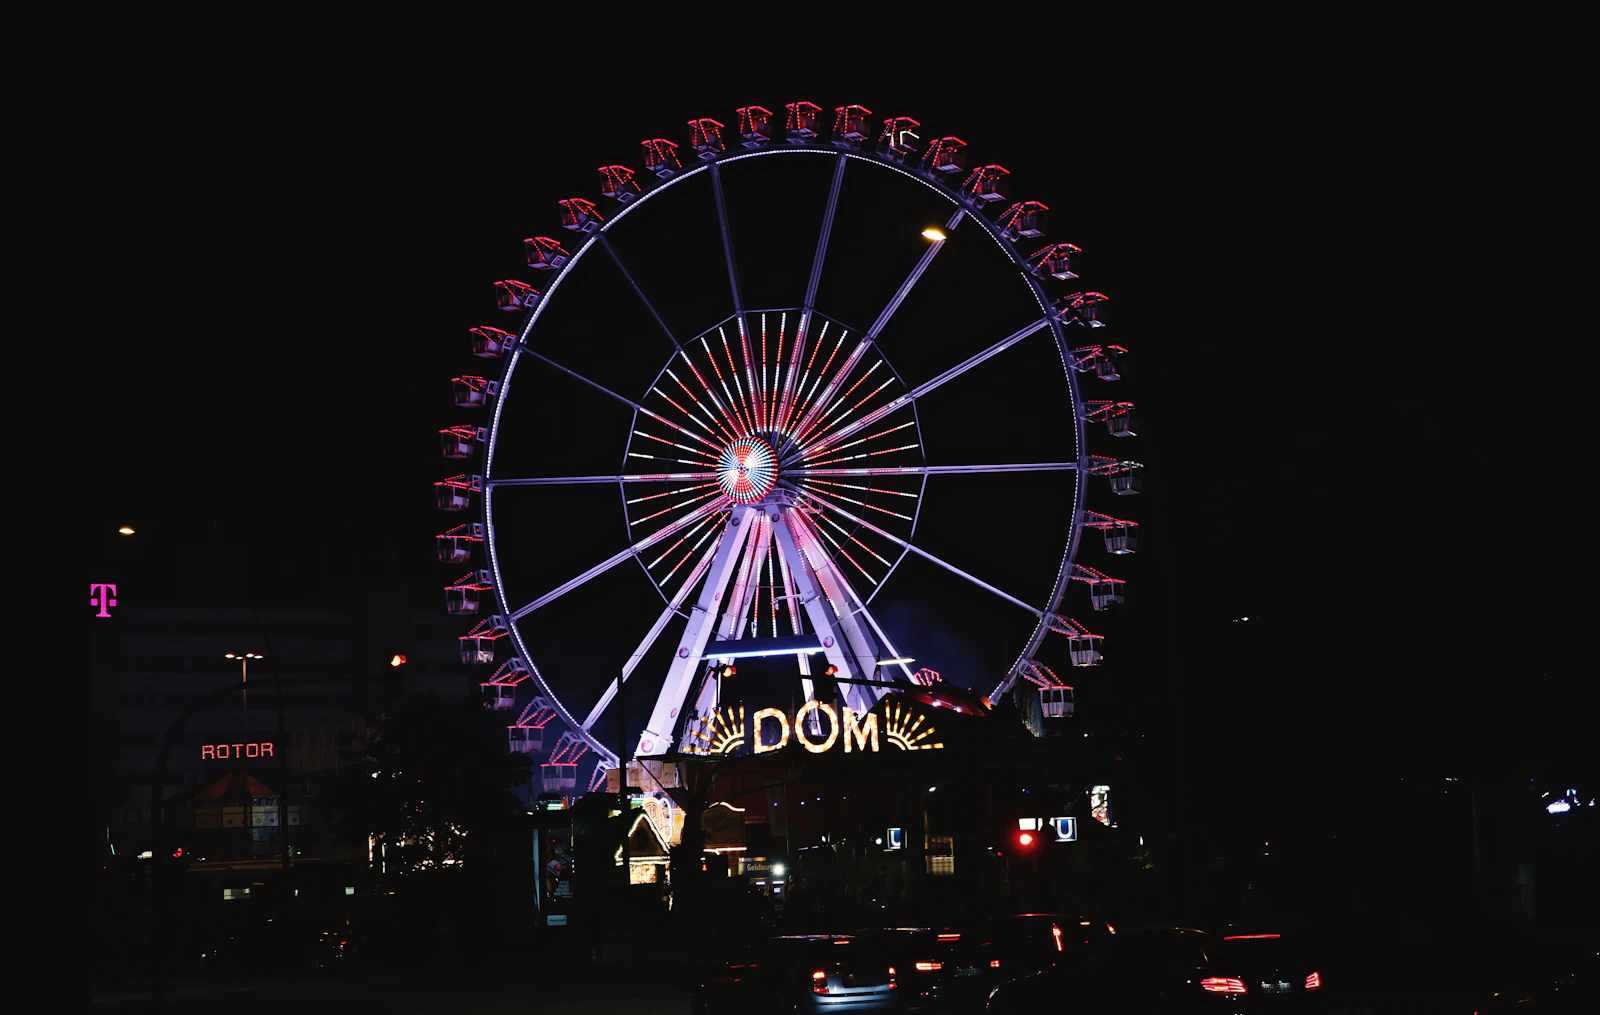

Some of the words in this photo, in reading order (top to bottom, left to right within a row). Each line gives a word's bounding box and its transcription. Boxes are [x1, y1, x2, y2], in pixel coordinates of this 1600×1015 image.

[91, 584, 116, 617] T
[753, 700, 879, 753] DOM
[202, 742, 274, 759] ROTOR
[1056, 819, 1073, 839] U
[747, 863, 774, 872] Geldaut
